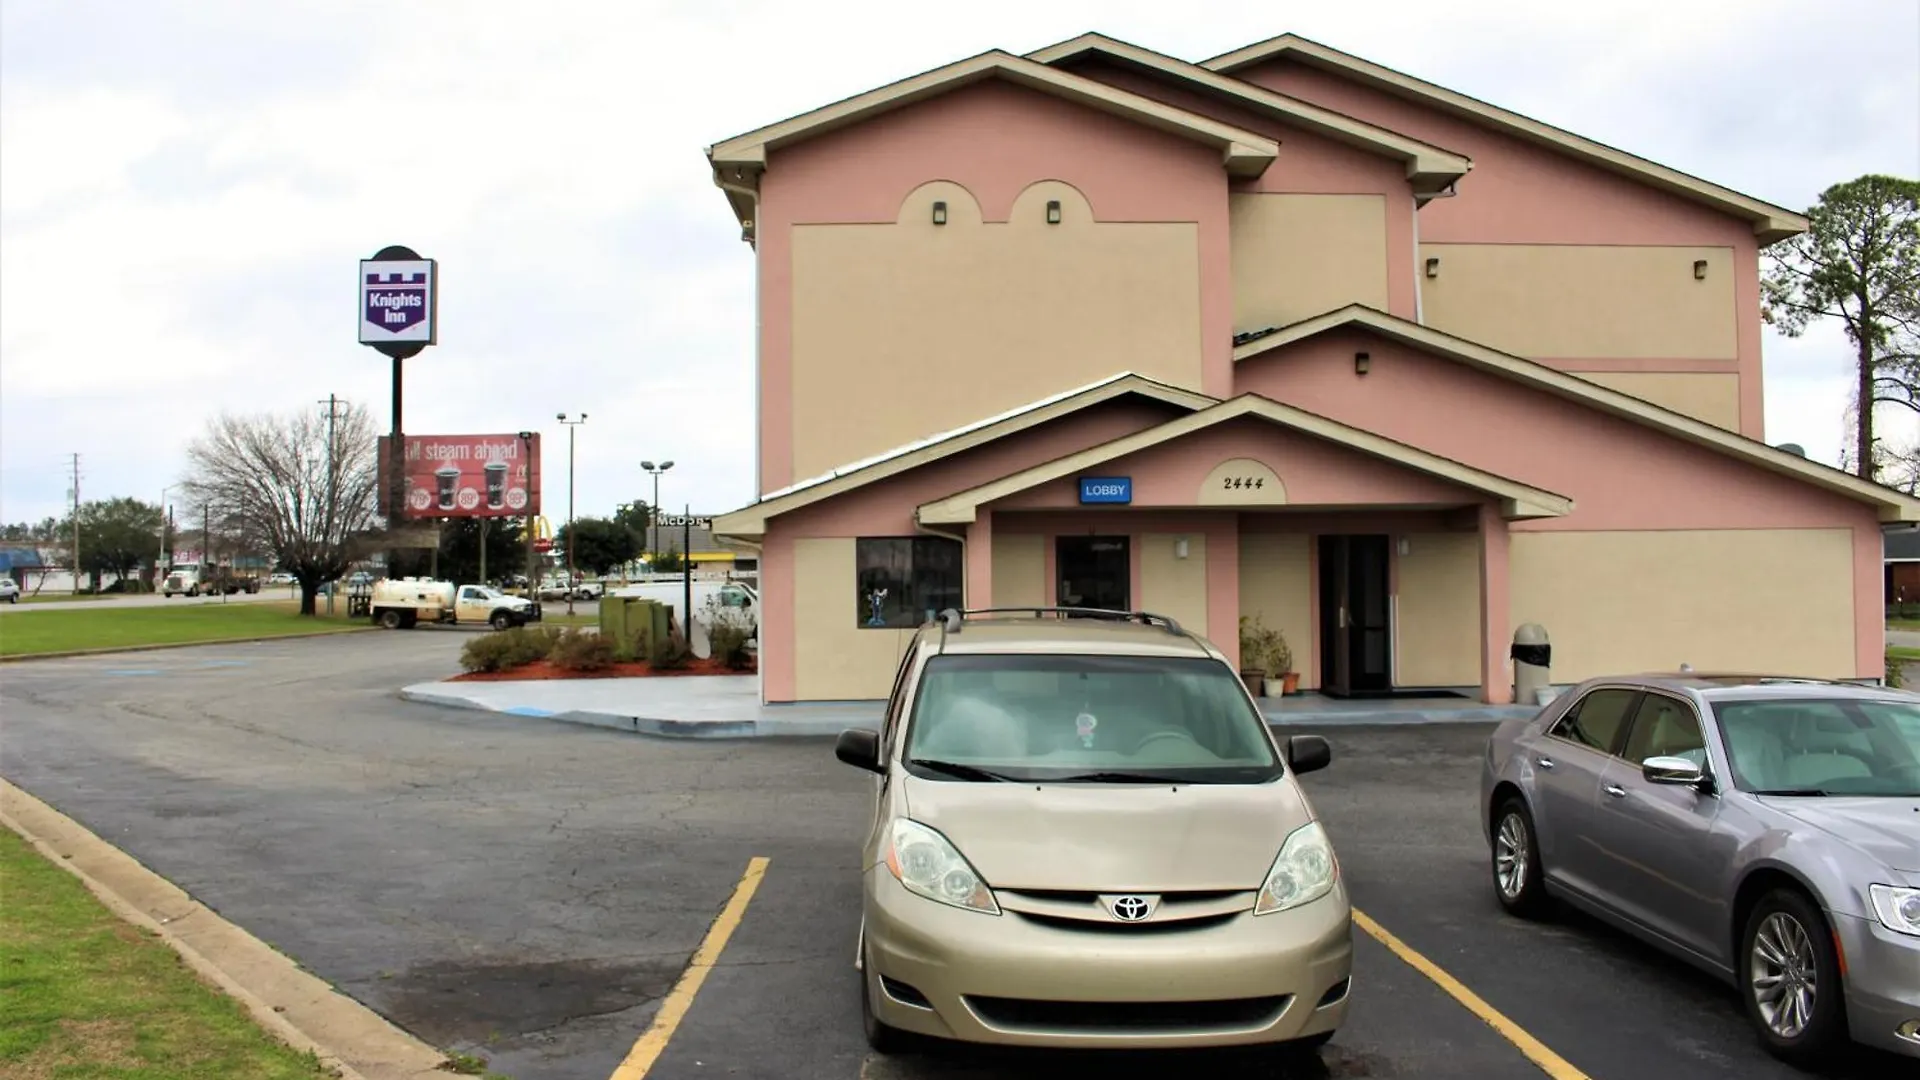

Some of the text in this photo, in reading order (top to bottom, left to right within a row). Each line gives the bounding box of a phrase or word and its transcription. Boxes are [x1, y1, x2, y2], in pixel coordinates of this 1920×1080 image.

[369, 293, 422, 309] Knights
[384, 309, 406, 323] Inn
[425, 442, 470, 460] steam
[475, 439, 518, 460] ahead
[1223, 477, 1264, 489] 2444
[1085, 485, 1126, 496] LOBBY
